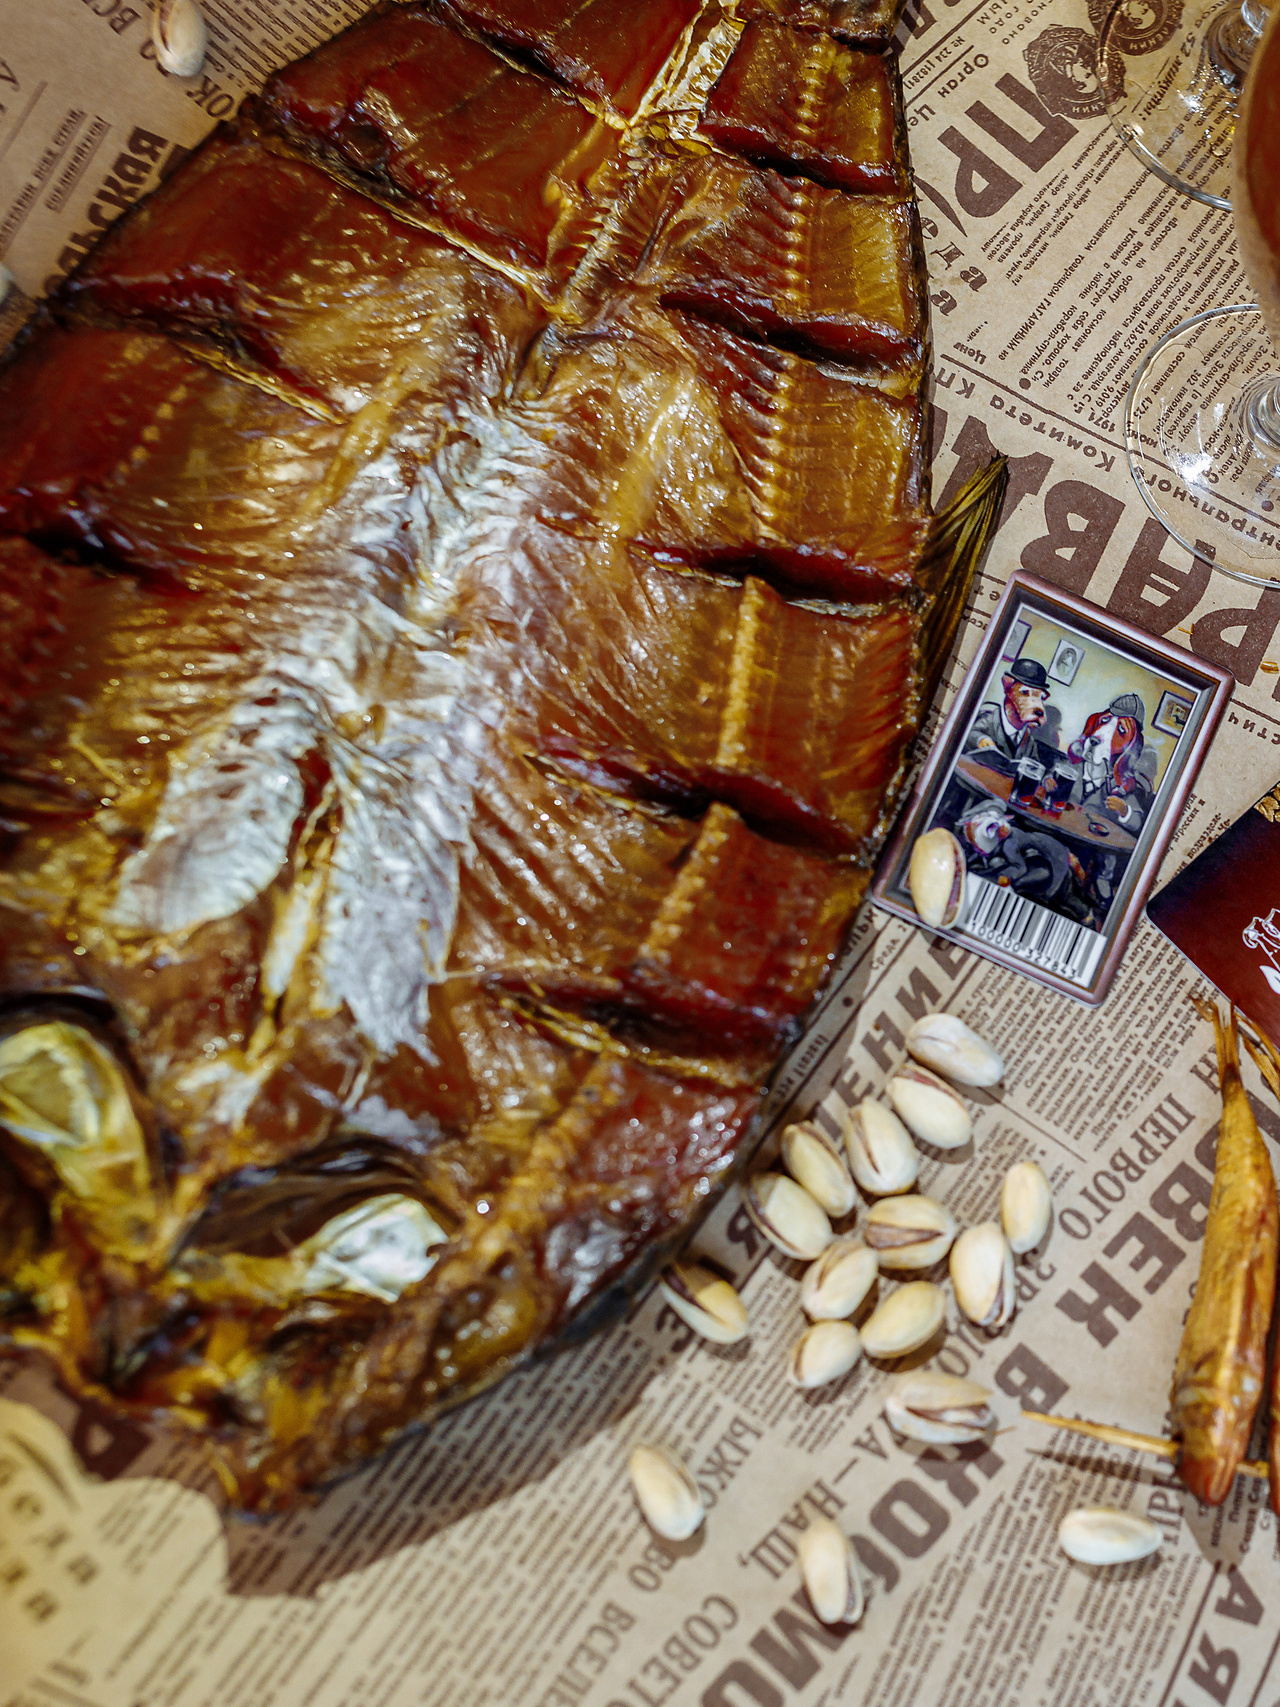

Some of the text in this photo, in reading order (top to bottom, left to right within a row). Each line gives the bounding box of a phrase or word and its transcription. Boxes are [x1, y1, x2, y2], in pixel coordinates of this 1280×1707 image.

[934, 46, 952, 62] 234
[937, 53, 989, 97] Орган
[920, 68, 1077, 230] ПР
[1120, 240, 1143, 266] время
[1161, 244, 1188, 274] систем
[1106, 272, 1134, 305] орбиту
[1121, 273, 1166, 327] производится
[1144, 298, 1163, 319] волн
[1006, 297, 1051, 350] ГАГАРИНЫМ
[1069, 308, 1091, 332] себя
[1071, 308, 1106, 352] космонавт
[989, 394, 1115, 471] Комитета
[1058, 1094, 1194, 1239] ПЕРВОГО
